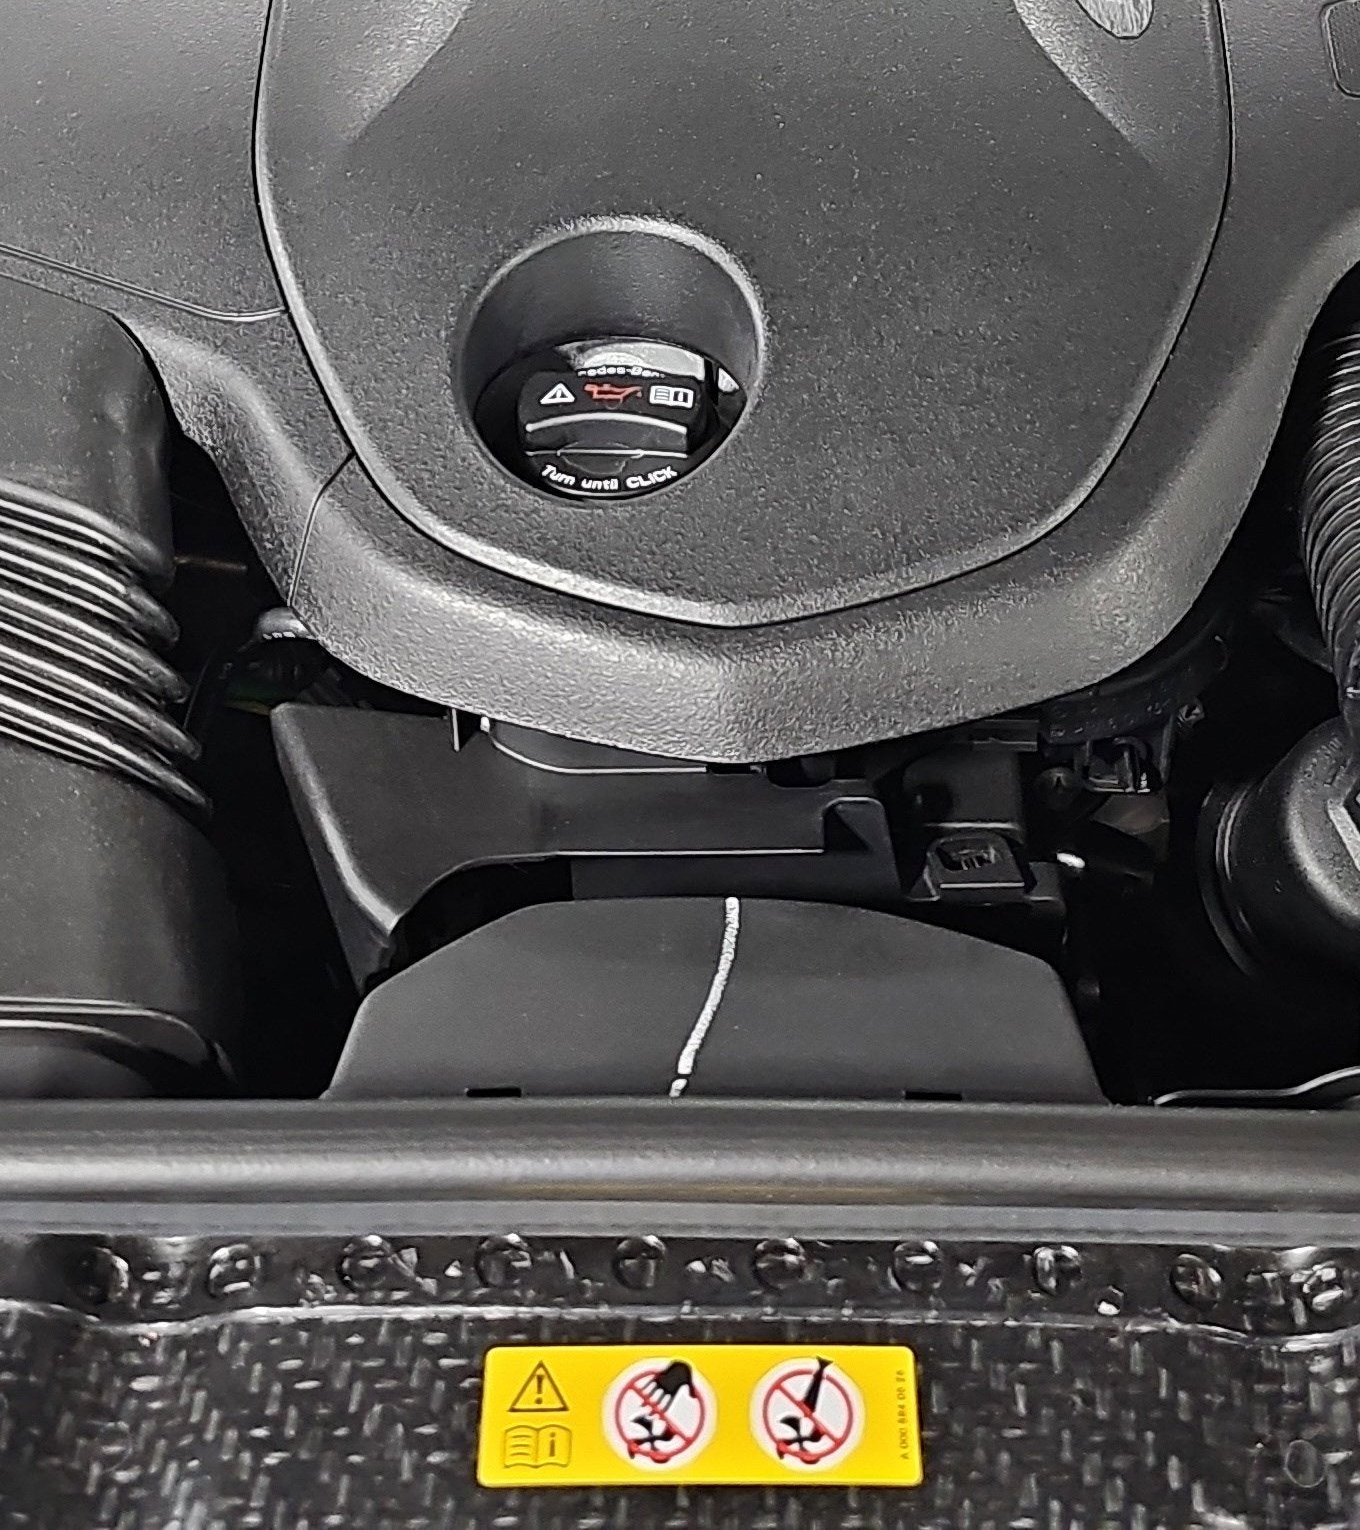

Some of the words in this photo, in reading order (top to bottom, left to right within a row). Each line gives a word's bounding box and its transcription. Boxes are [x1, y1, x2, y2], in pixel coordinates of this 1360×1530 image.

[541, 464, 576, 486] Turn
[581, 478, 619, 490] until
[625, 465, 678, 489] CLICK
